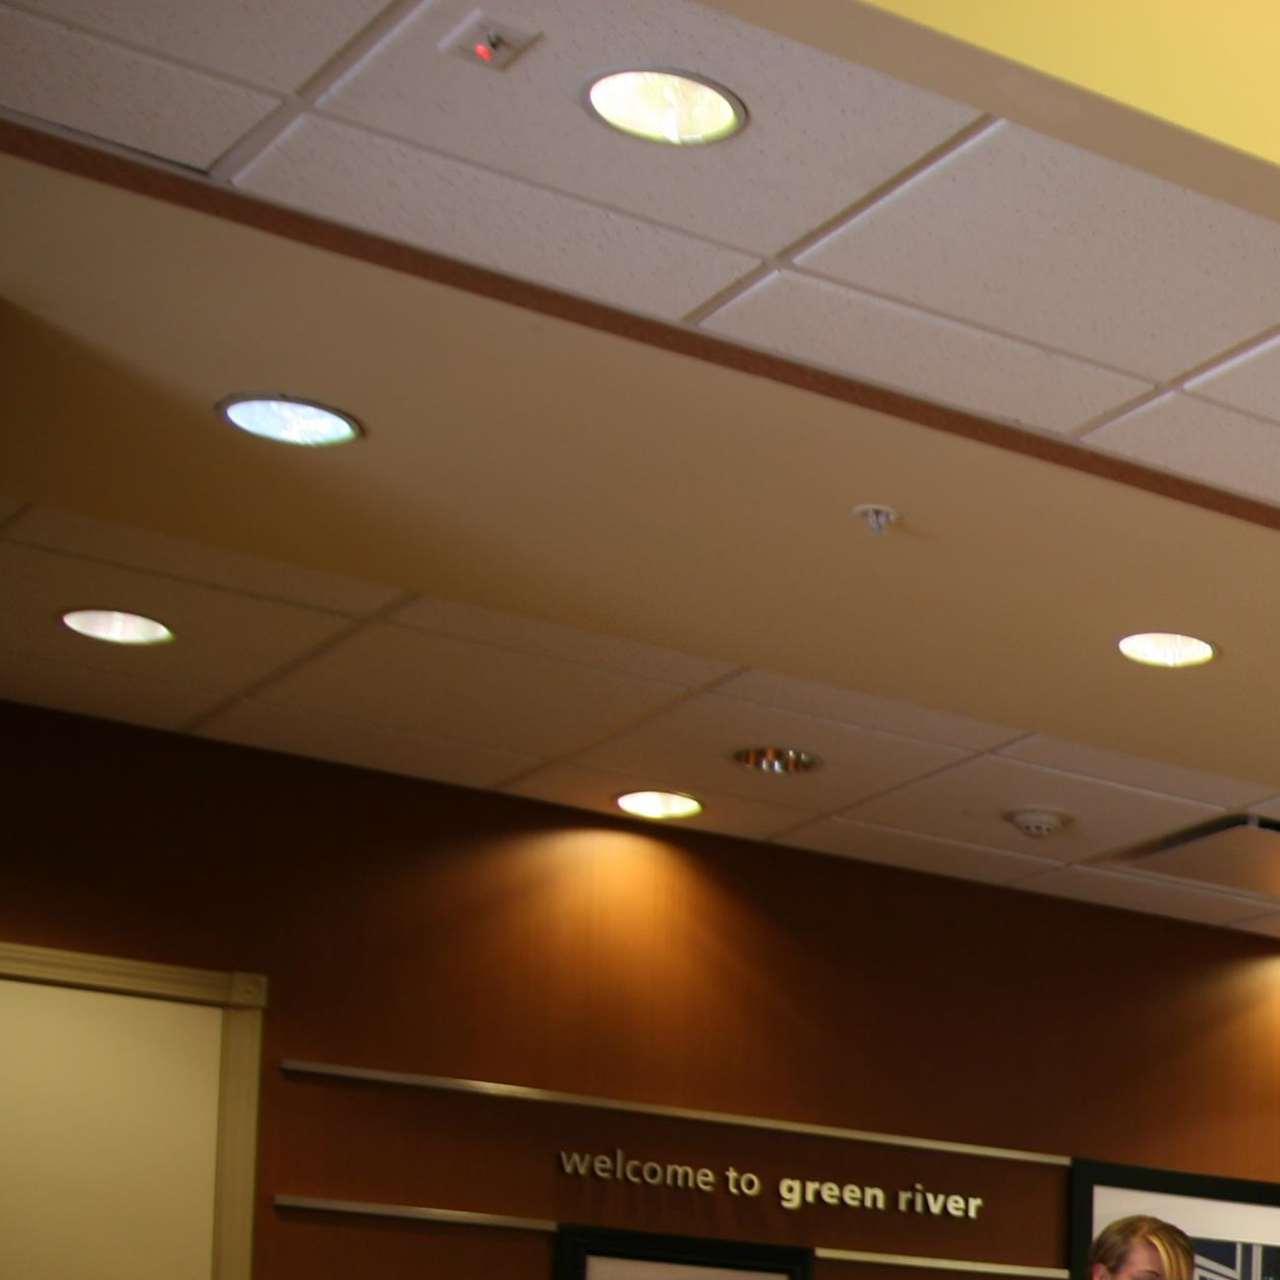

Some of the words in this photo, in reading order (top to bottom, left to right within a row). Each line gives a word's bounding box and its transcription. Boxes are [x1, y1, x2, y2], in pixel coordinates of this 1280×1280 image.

[560, 1147, 715, 1192] welcome
[726, 1166, 760, 1196] to
[779, 1174, 885, 1209] green
[899, 1183, 984, 1219] river
